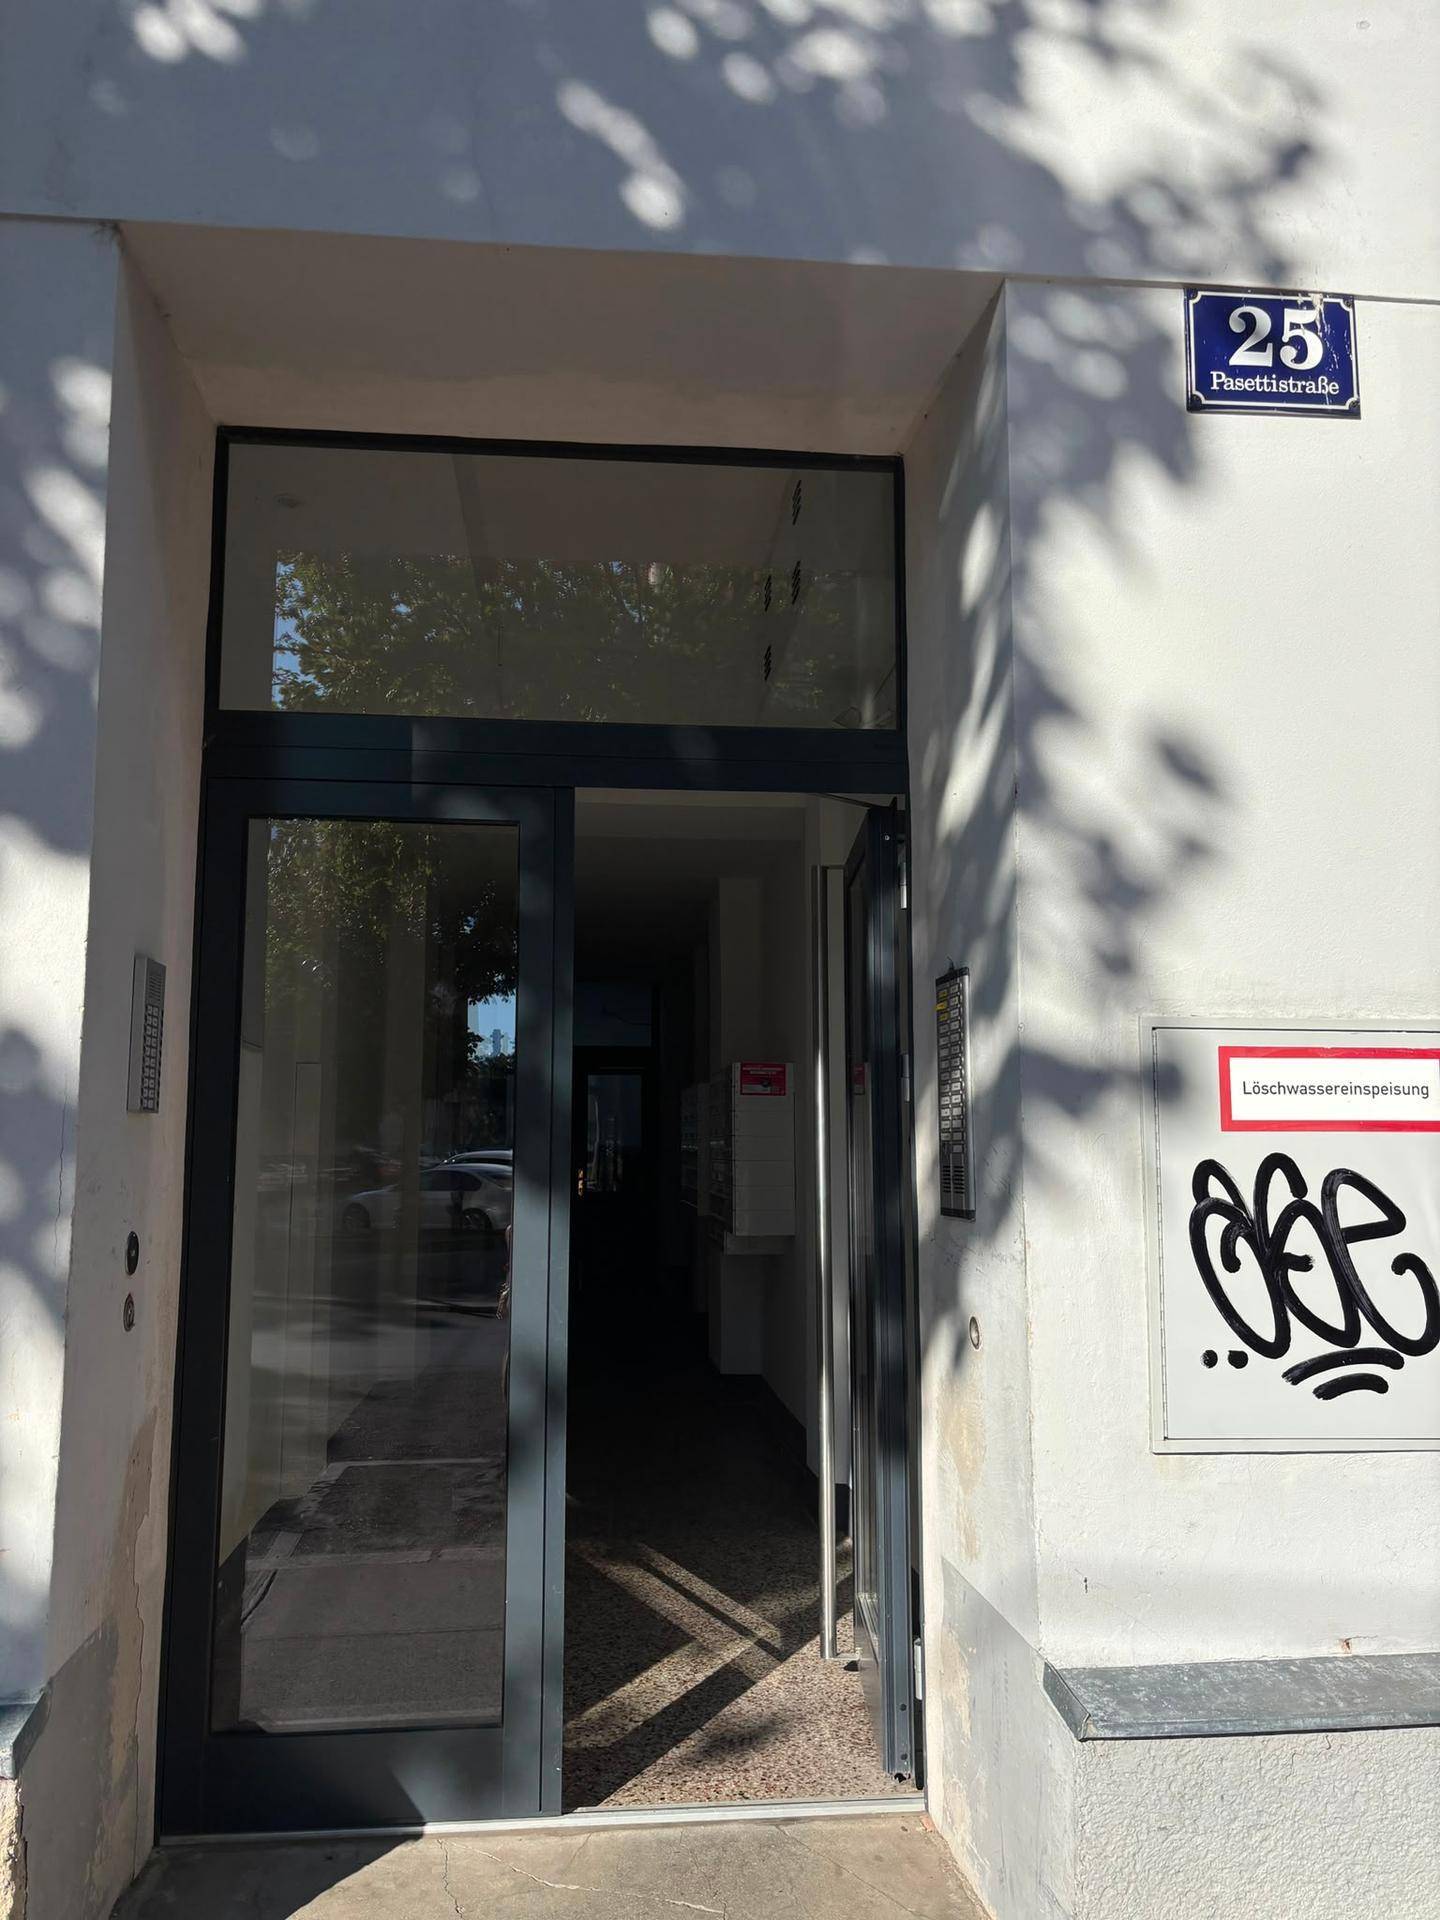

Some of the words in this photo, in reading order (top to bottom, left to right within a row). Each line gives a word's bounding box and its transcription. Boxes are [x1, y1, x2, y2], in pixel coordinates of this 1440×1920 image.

[1228, 305, 1324, 370] 25
[1209, 371, 1340, 395] Pasettistraße
[1242, 1080, 1430, 1100] Löschwassereinspeisung
